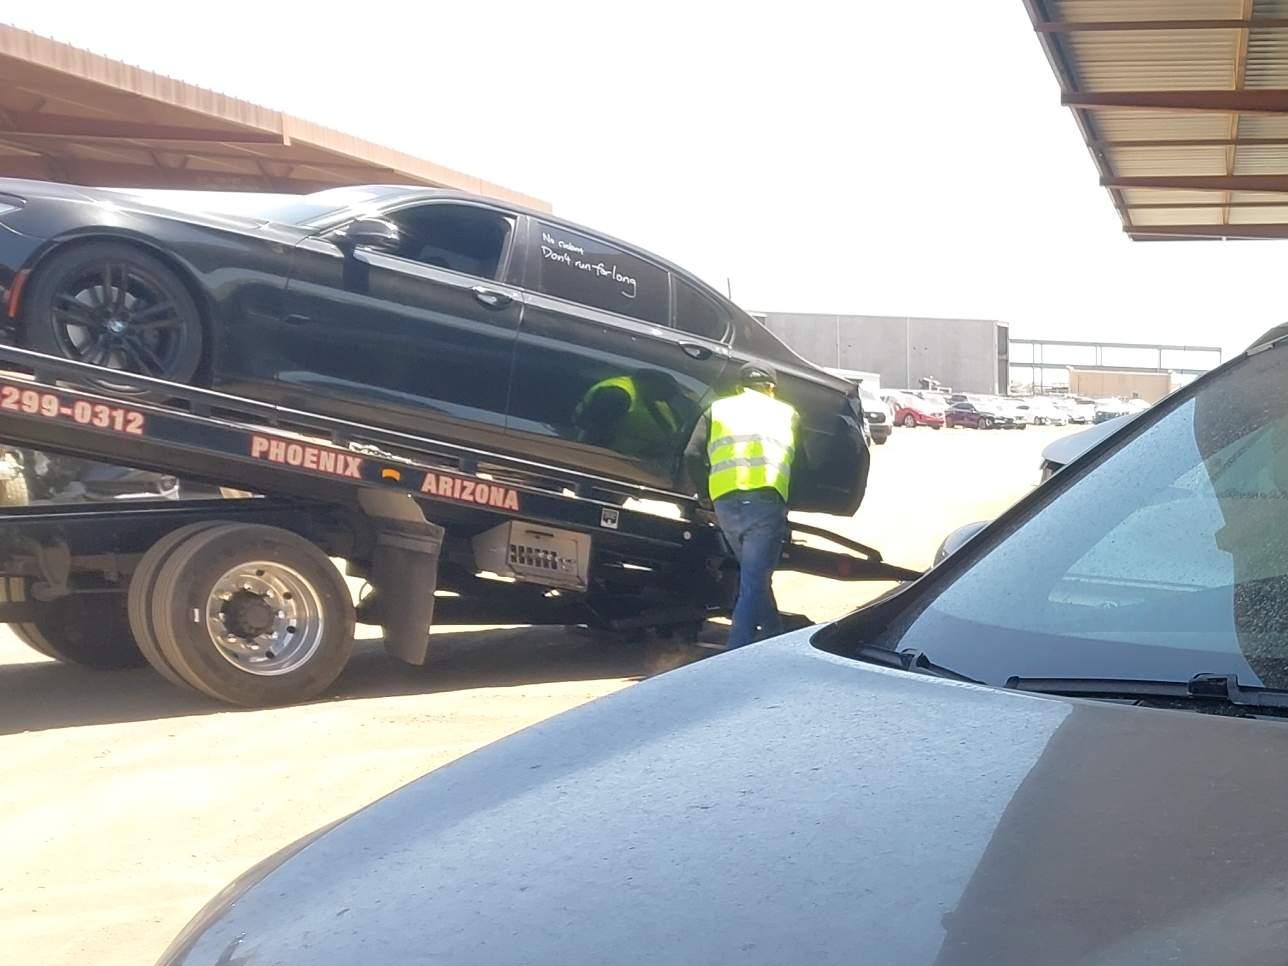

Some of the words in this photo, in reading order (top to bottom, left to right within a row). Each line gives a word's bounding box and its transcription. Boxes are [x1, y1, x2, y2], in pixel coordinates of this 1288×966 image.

[574, 260, 592, 272] run
[592, 262, 612, 277] for
[612, 264, 637, 299] long
[1, 386, 145, 435] 299-0312
[251, 435, 364, 479] PHOENIX
[420, 472, 520, 511] ARIZONA
